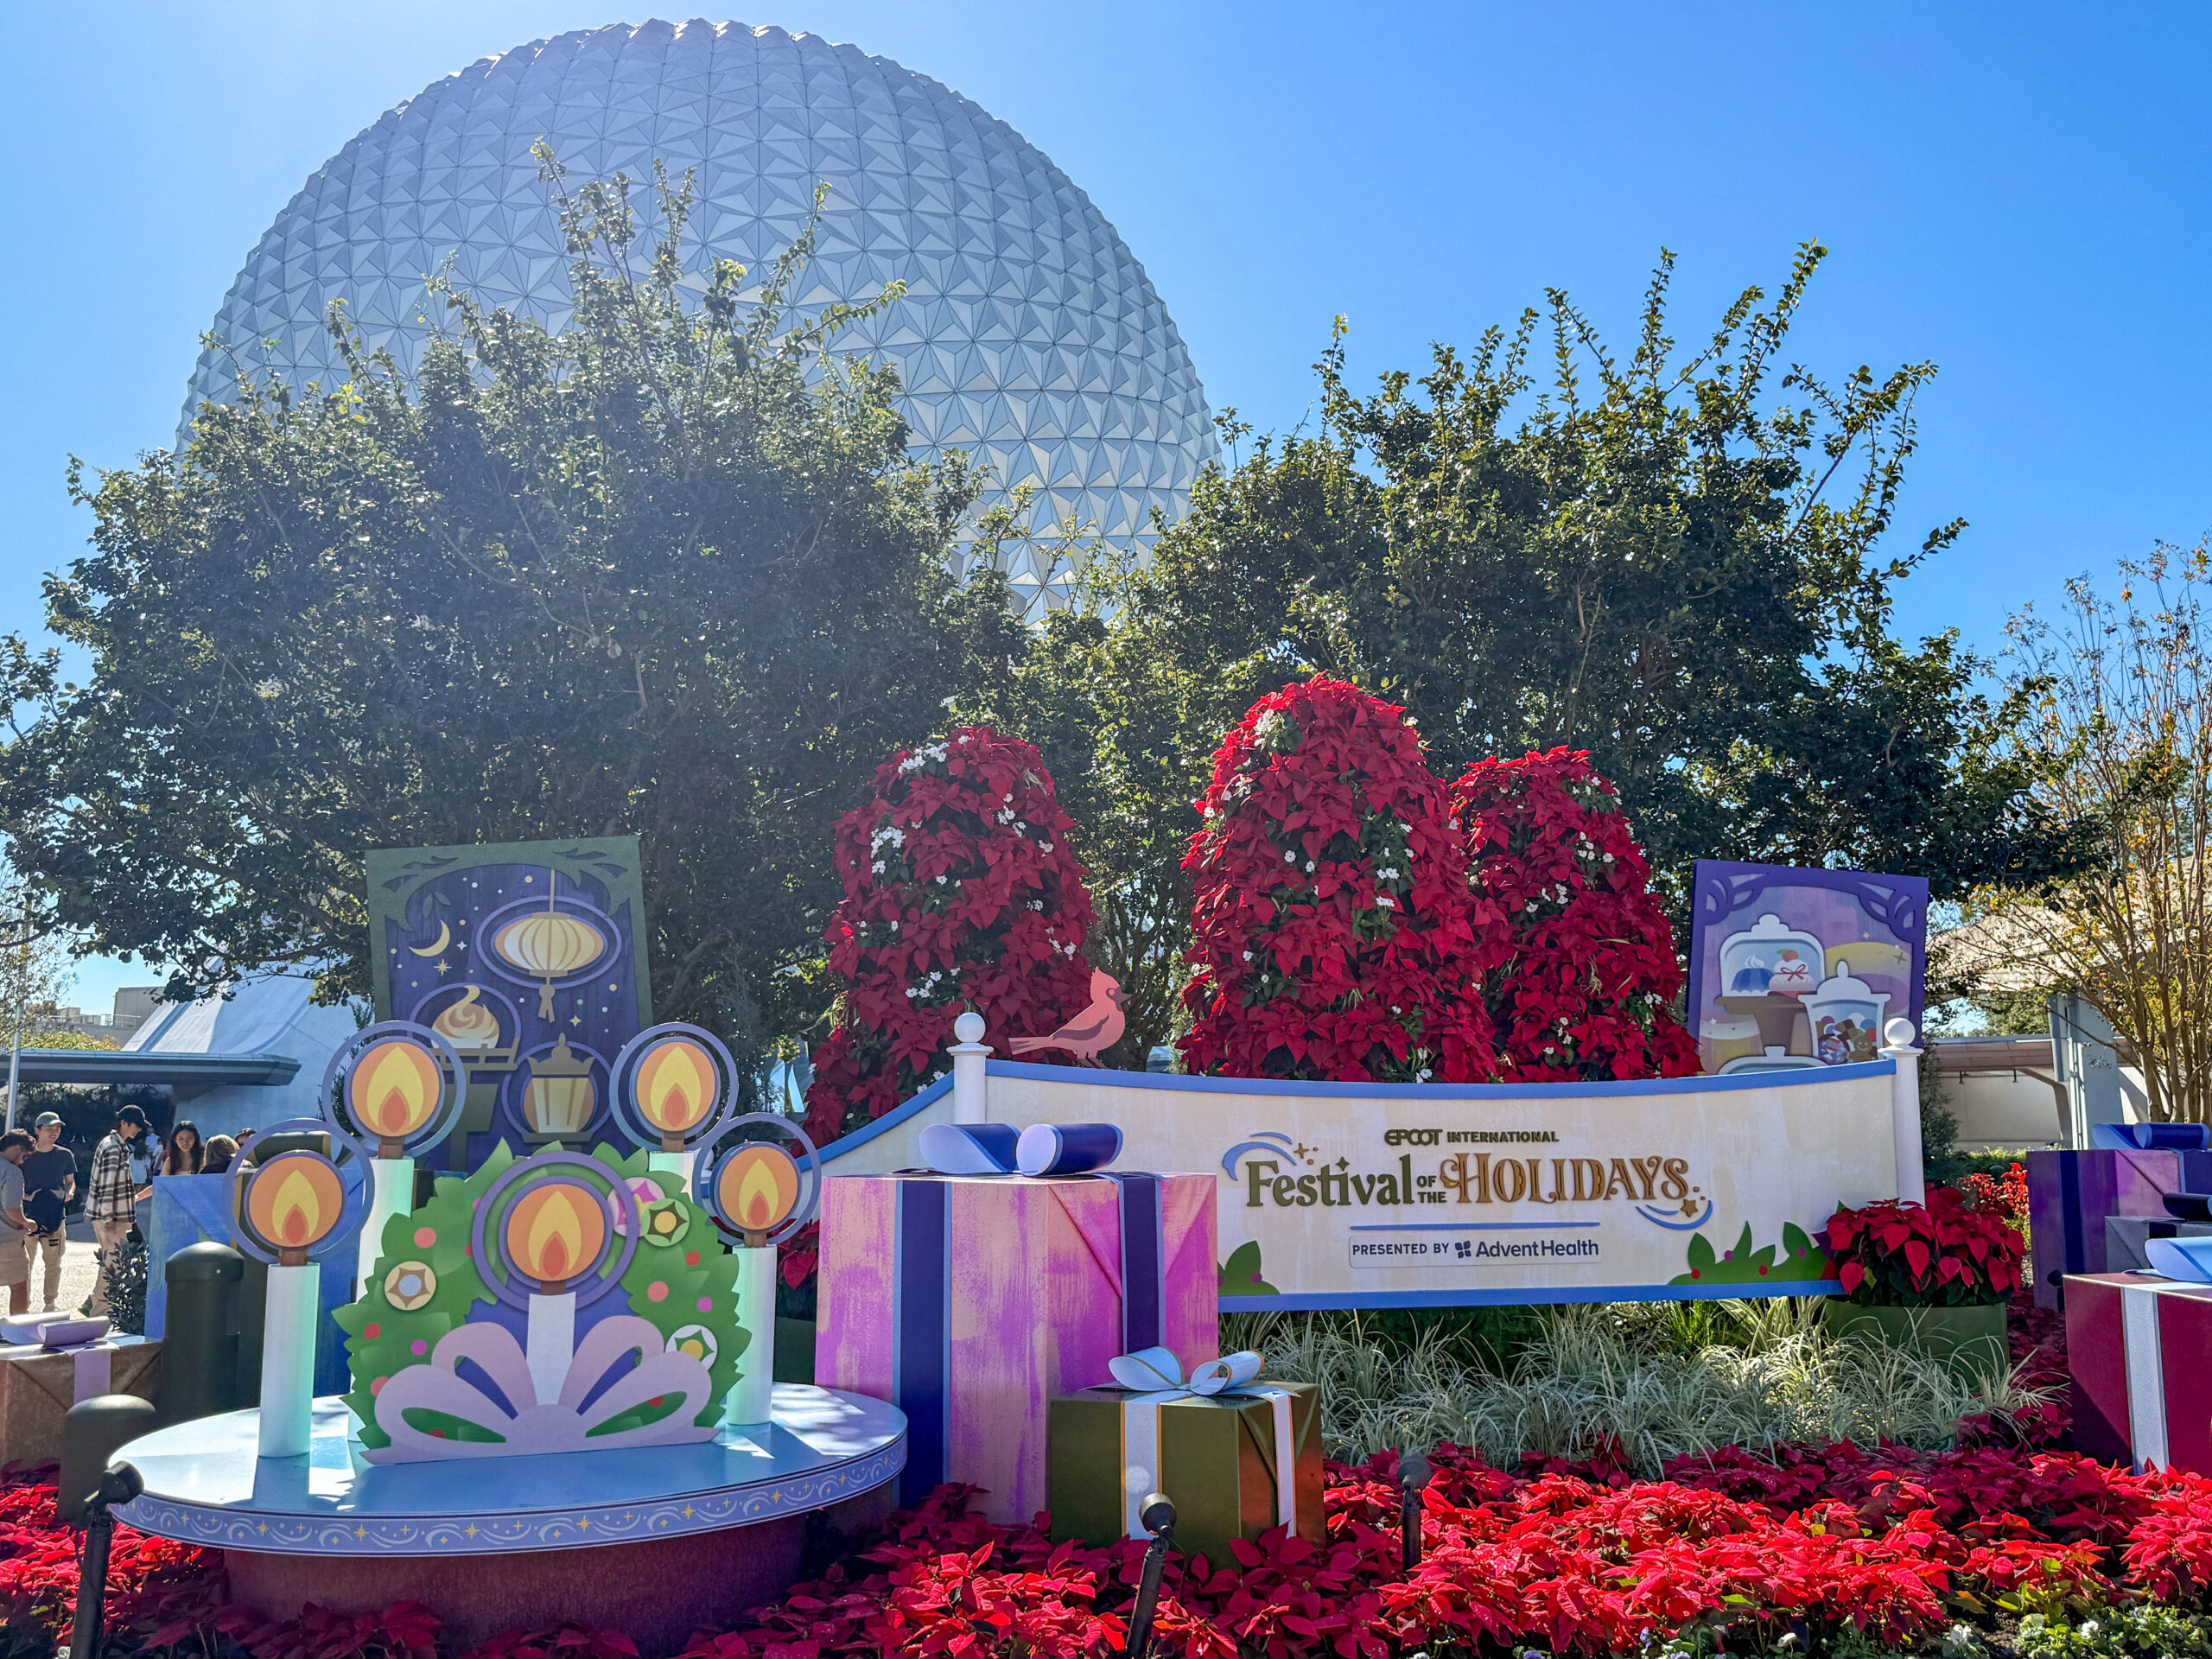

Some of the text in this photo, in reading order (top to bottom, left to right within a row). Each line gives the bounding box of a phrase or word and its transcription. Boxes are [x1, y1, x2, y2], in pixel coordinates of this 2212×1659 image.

[1384, 1128, 1560, 1146] EPCOT INTERNATIONAL
[1246, 1153, 1688, 1206] Festival OF THE HOLIDAYS
[1352, 1243, 1427, 1255] PRESENTED
[1433, 1243, 1450, 1254] BY
